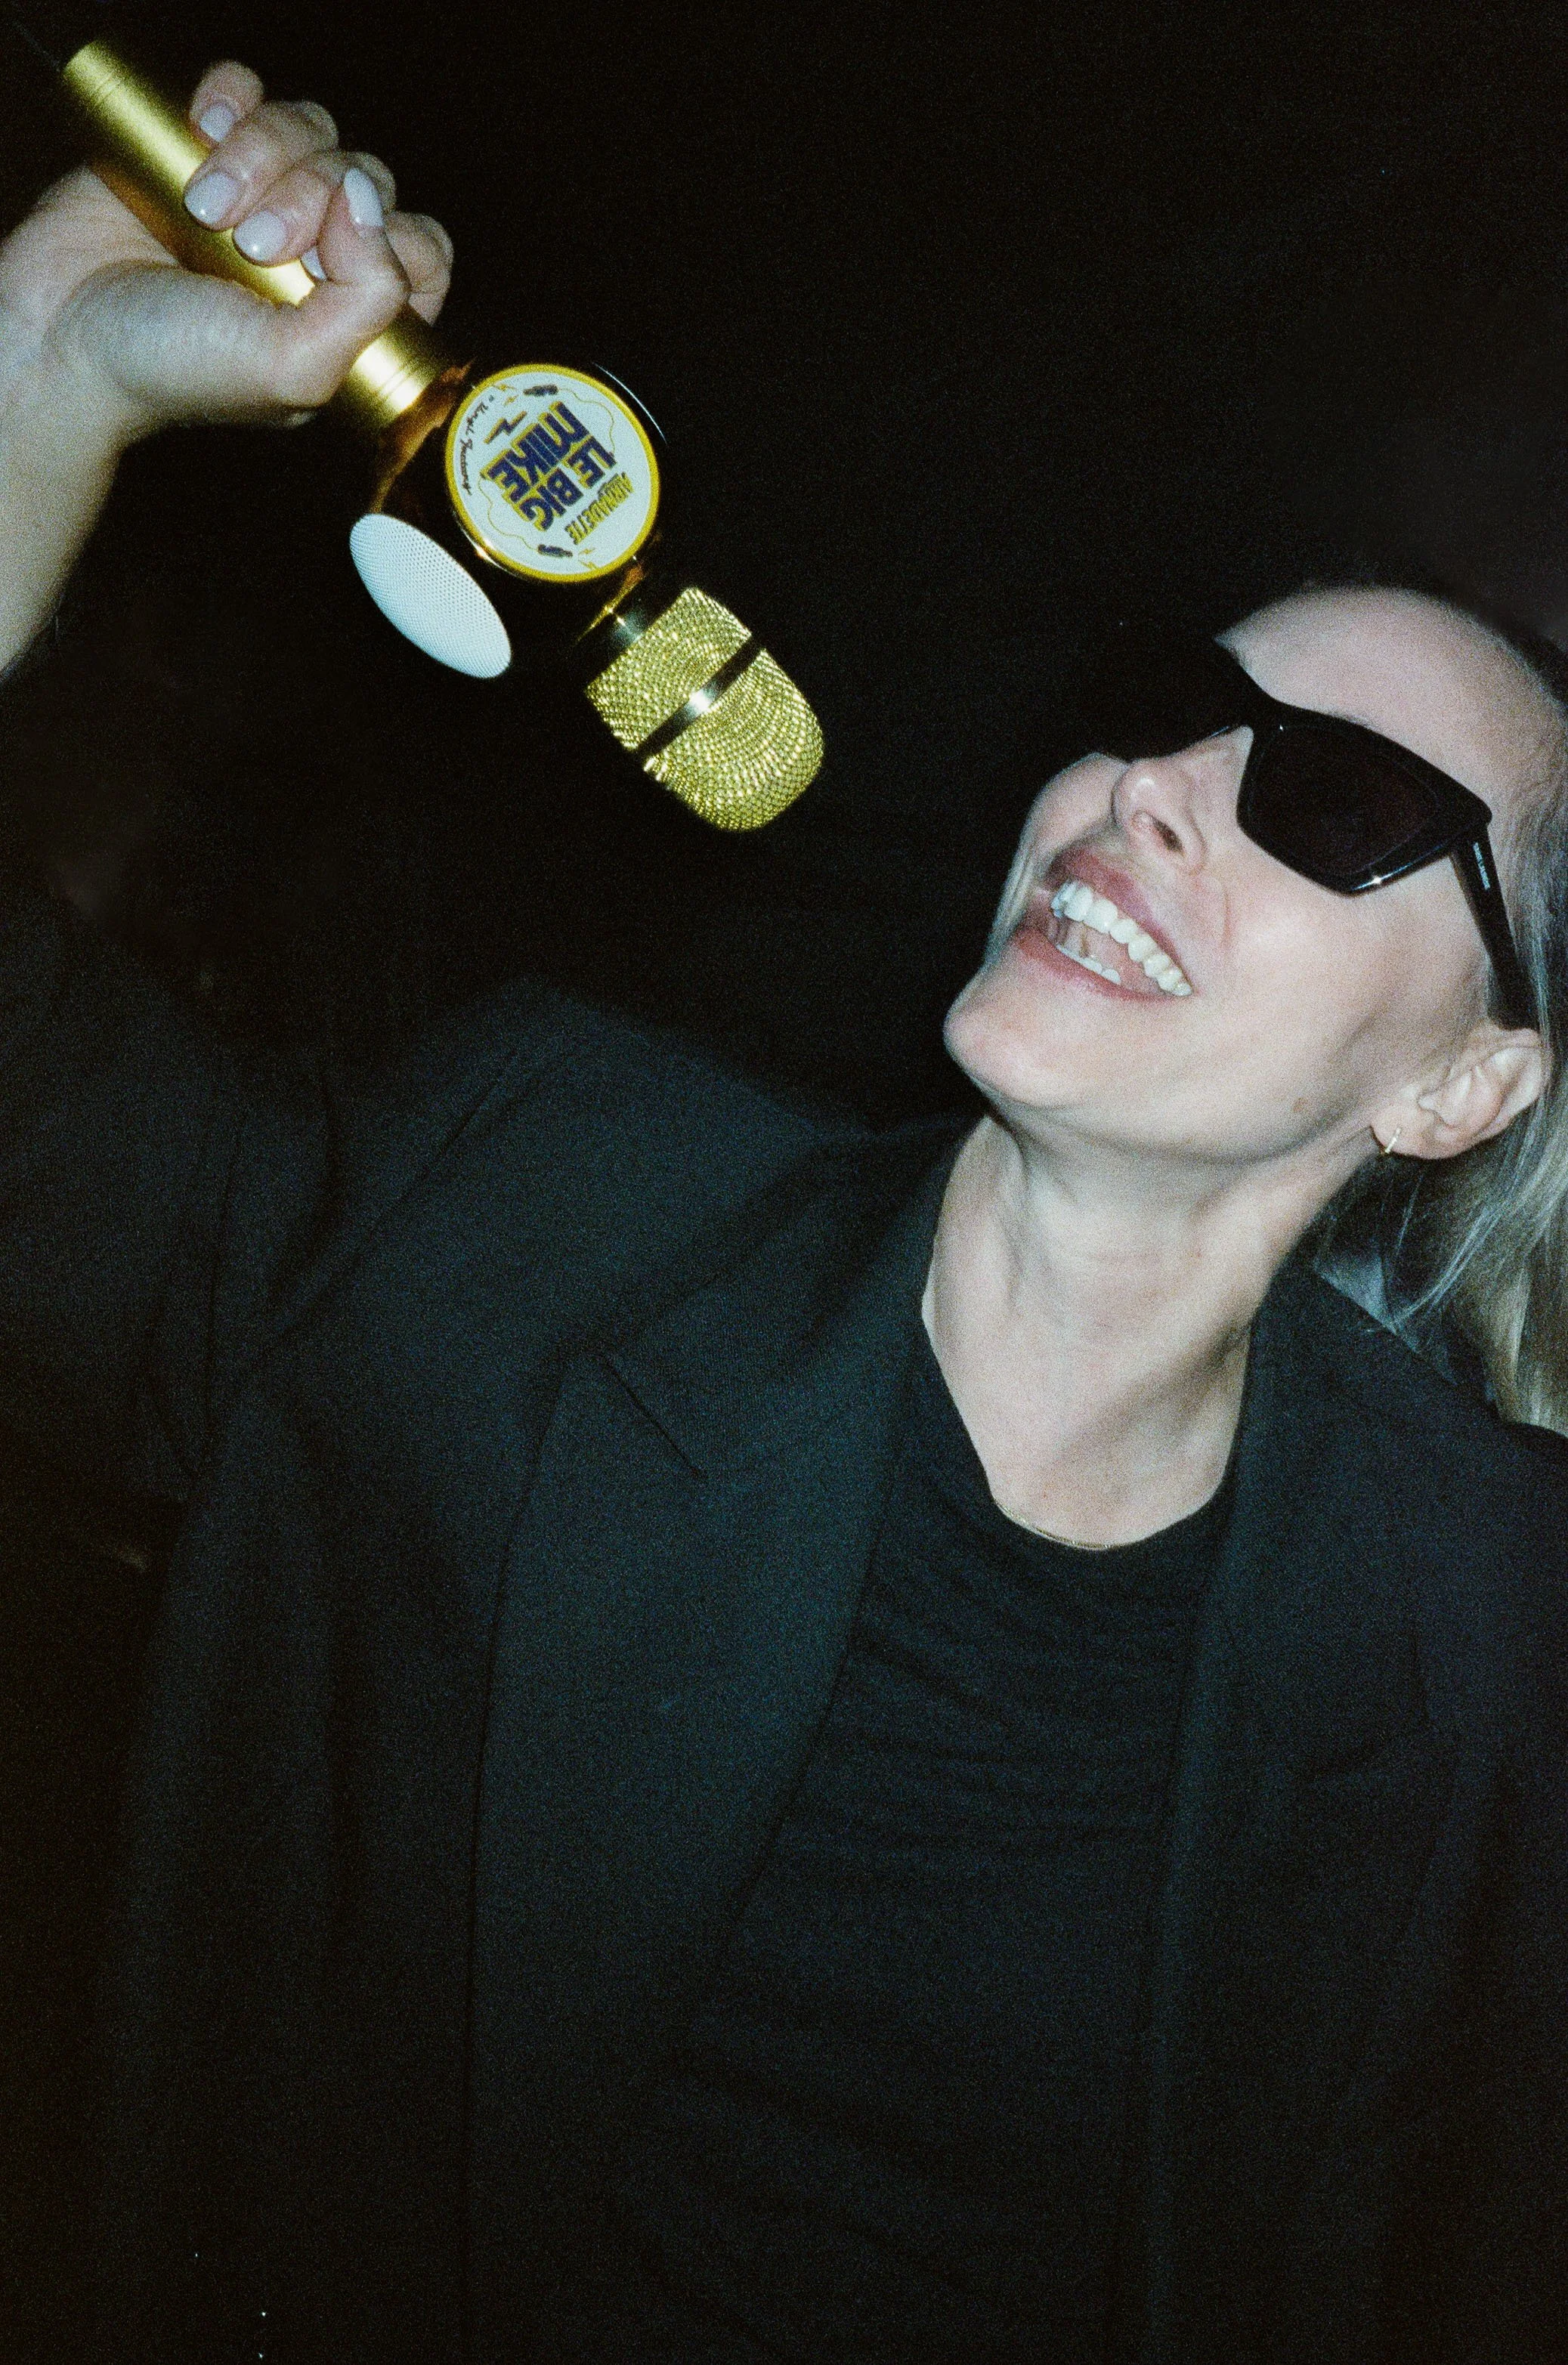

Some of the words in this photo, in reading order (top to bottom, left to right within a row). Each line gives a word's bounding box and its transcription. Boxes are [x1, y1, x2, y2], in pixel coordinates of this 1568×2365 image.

[481, 400, 591, 504] MIKE
[565, 434, 617, 490] LE
[517, 466, 584, 532] BIG
[564, 471, 635, 545] AIRNADETTE
